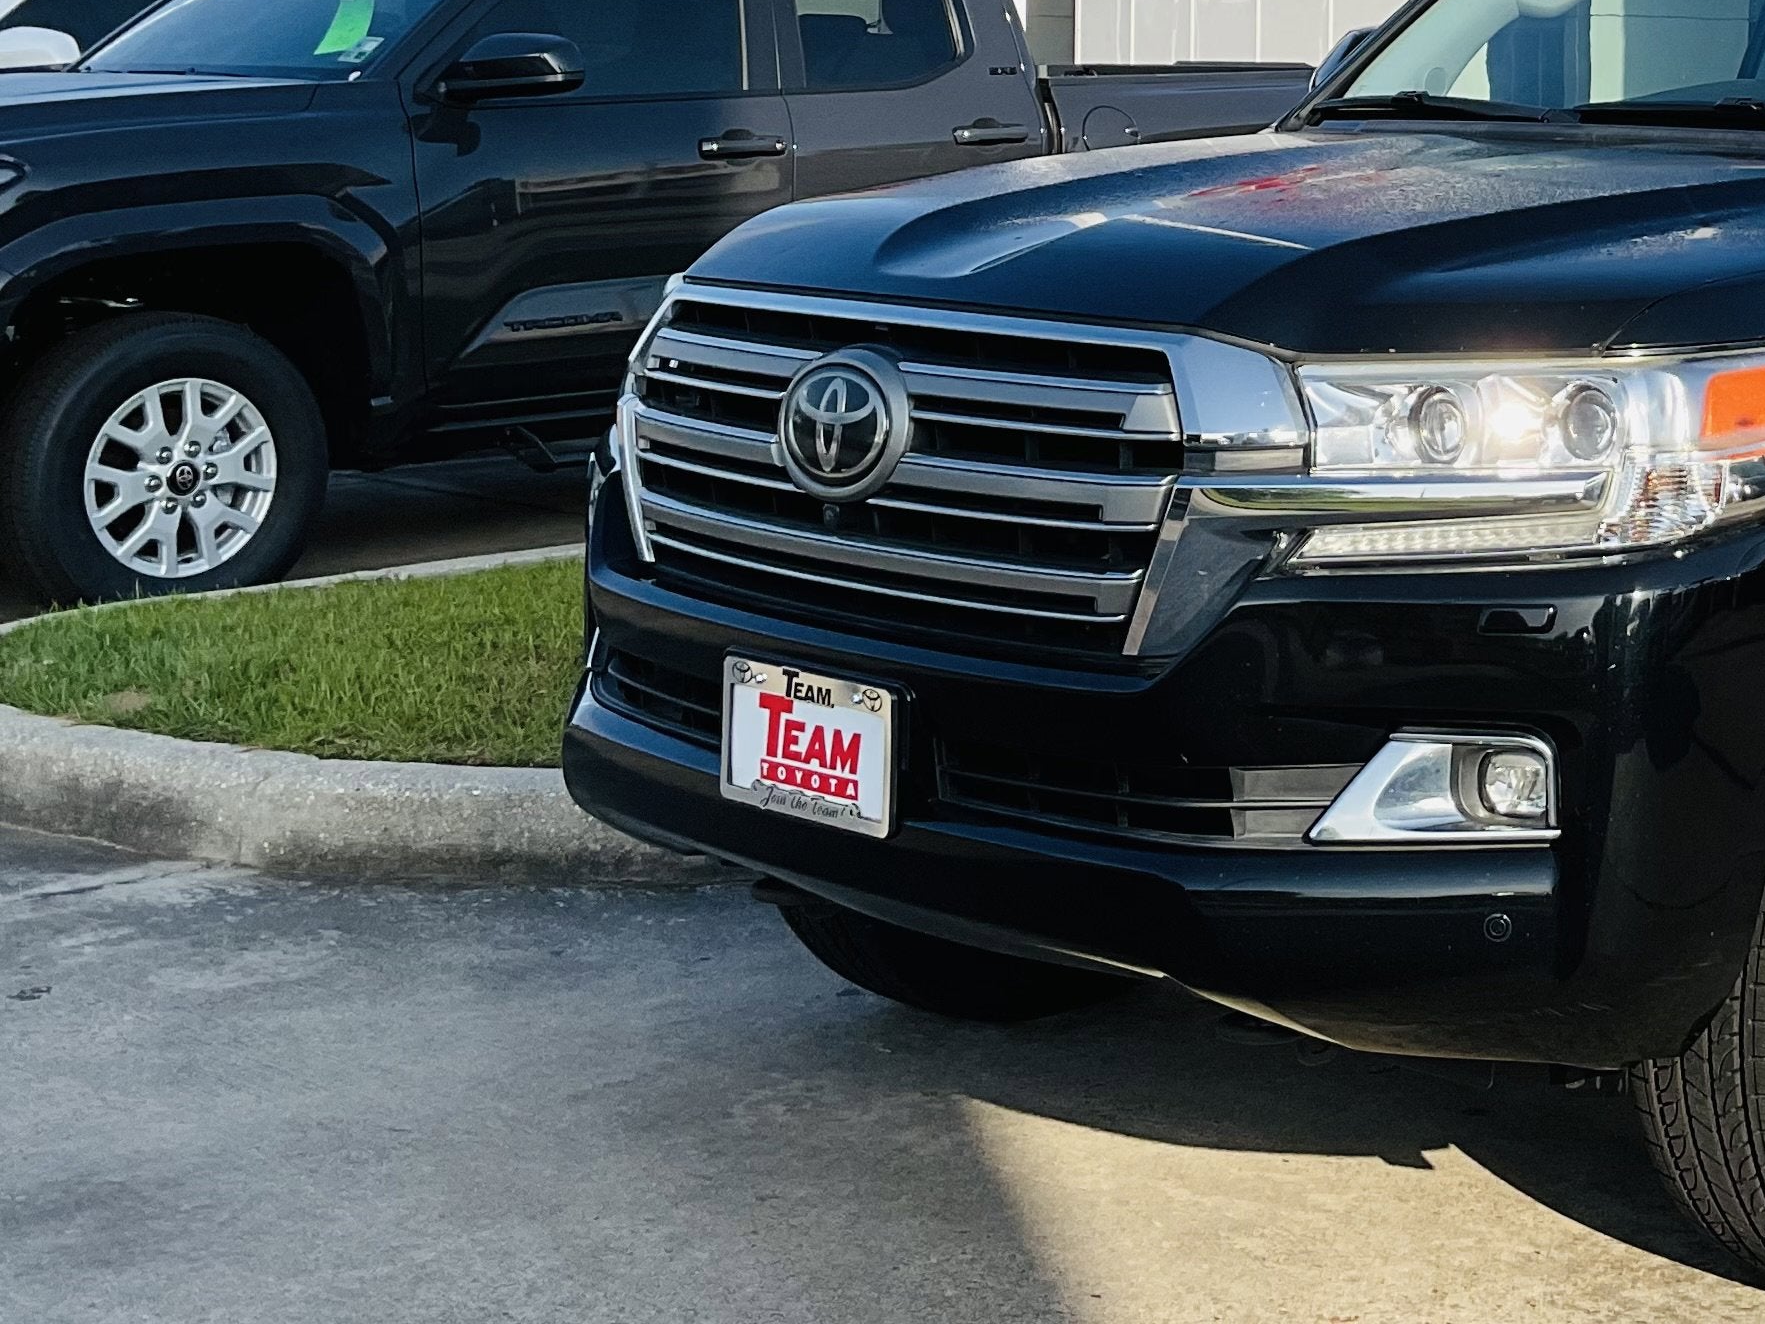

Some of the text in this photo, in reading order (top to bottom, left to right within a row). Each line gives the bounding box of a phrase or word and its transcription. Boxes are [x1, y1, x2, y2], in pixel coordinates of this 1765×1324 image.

[758, 691, 862, 775] TEAM
[760, 762, 857, 797] TOYOTA
[760, 786, 787, 807] Join
[790, 796, 808, 812] the
